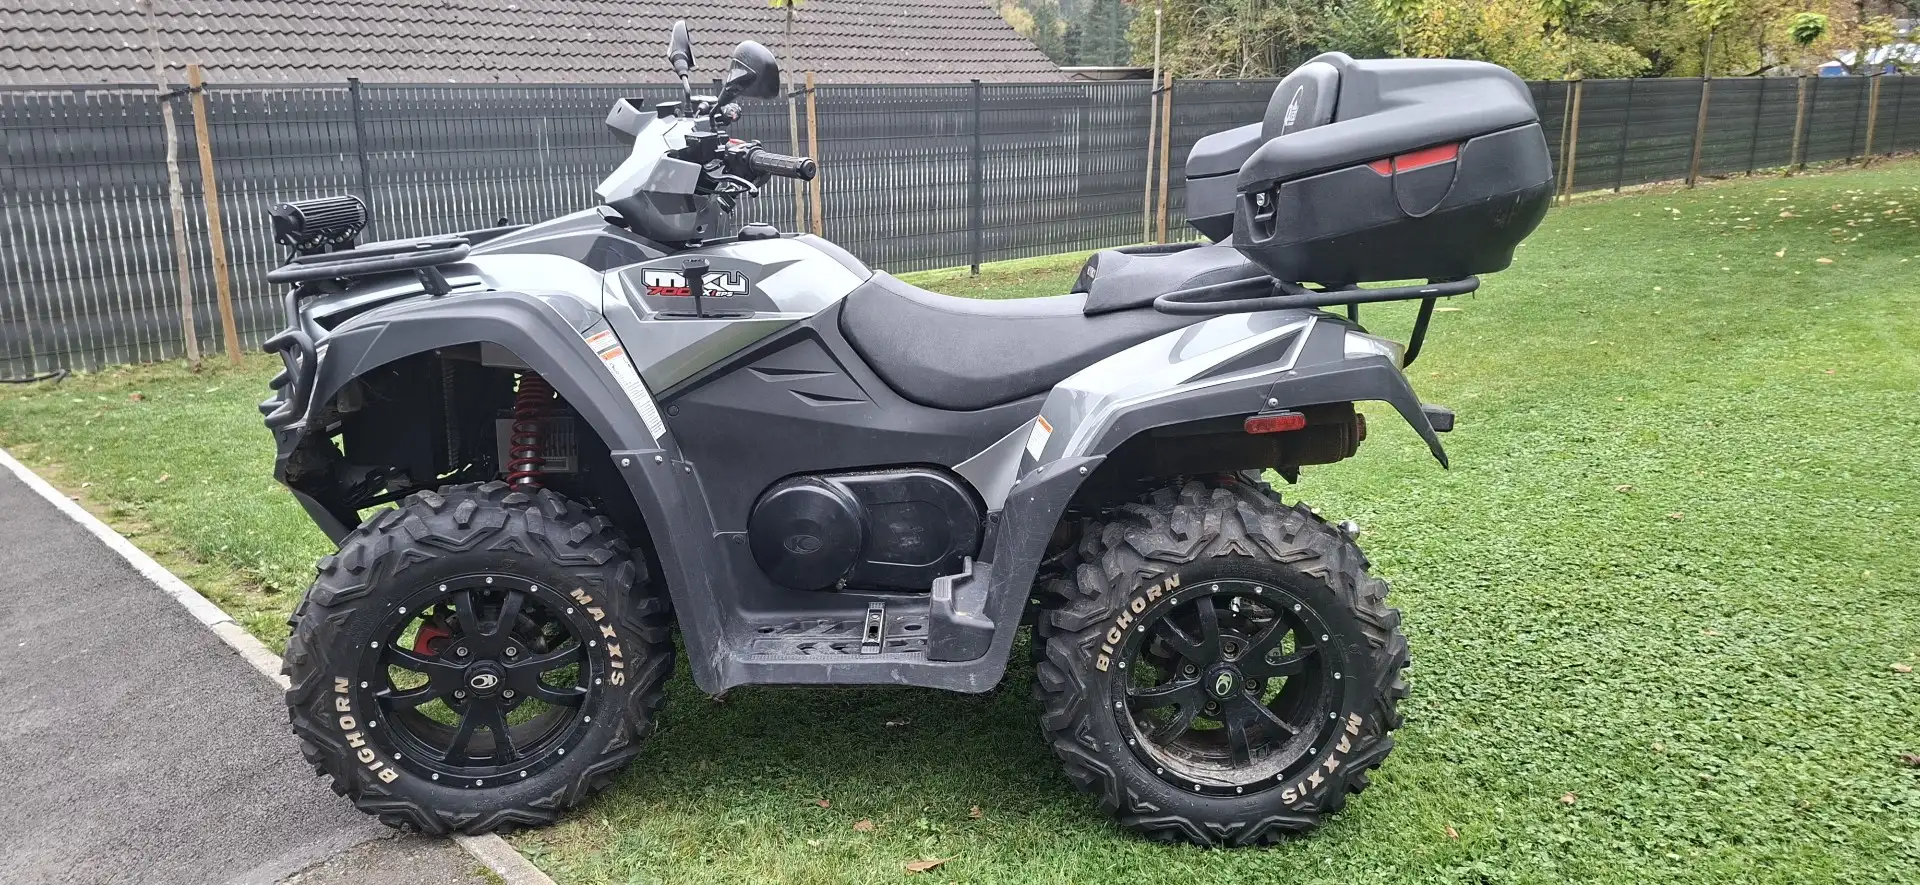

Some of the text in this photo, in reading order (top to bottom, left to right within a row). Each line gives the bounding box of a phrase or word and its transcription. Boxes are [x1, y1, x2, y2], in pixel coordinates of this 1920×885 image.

[570, 587, 625, 687] MAXXIS
[1095, 572, 1181, 673] BIGHORN
[333, 676, 400, 784] BIGHORN
[1281, 711, 1362, 805] MAXXIS
